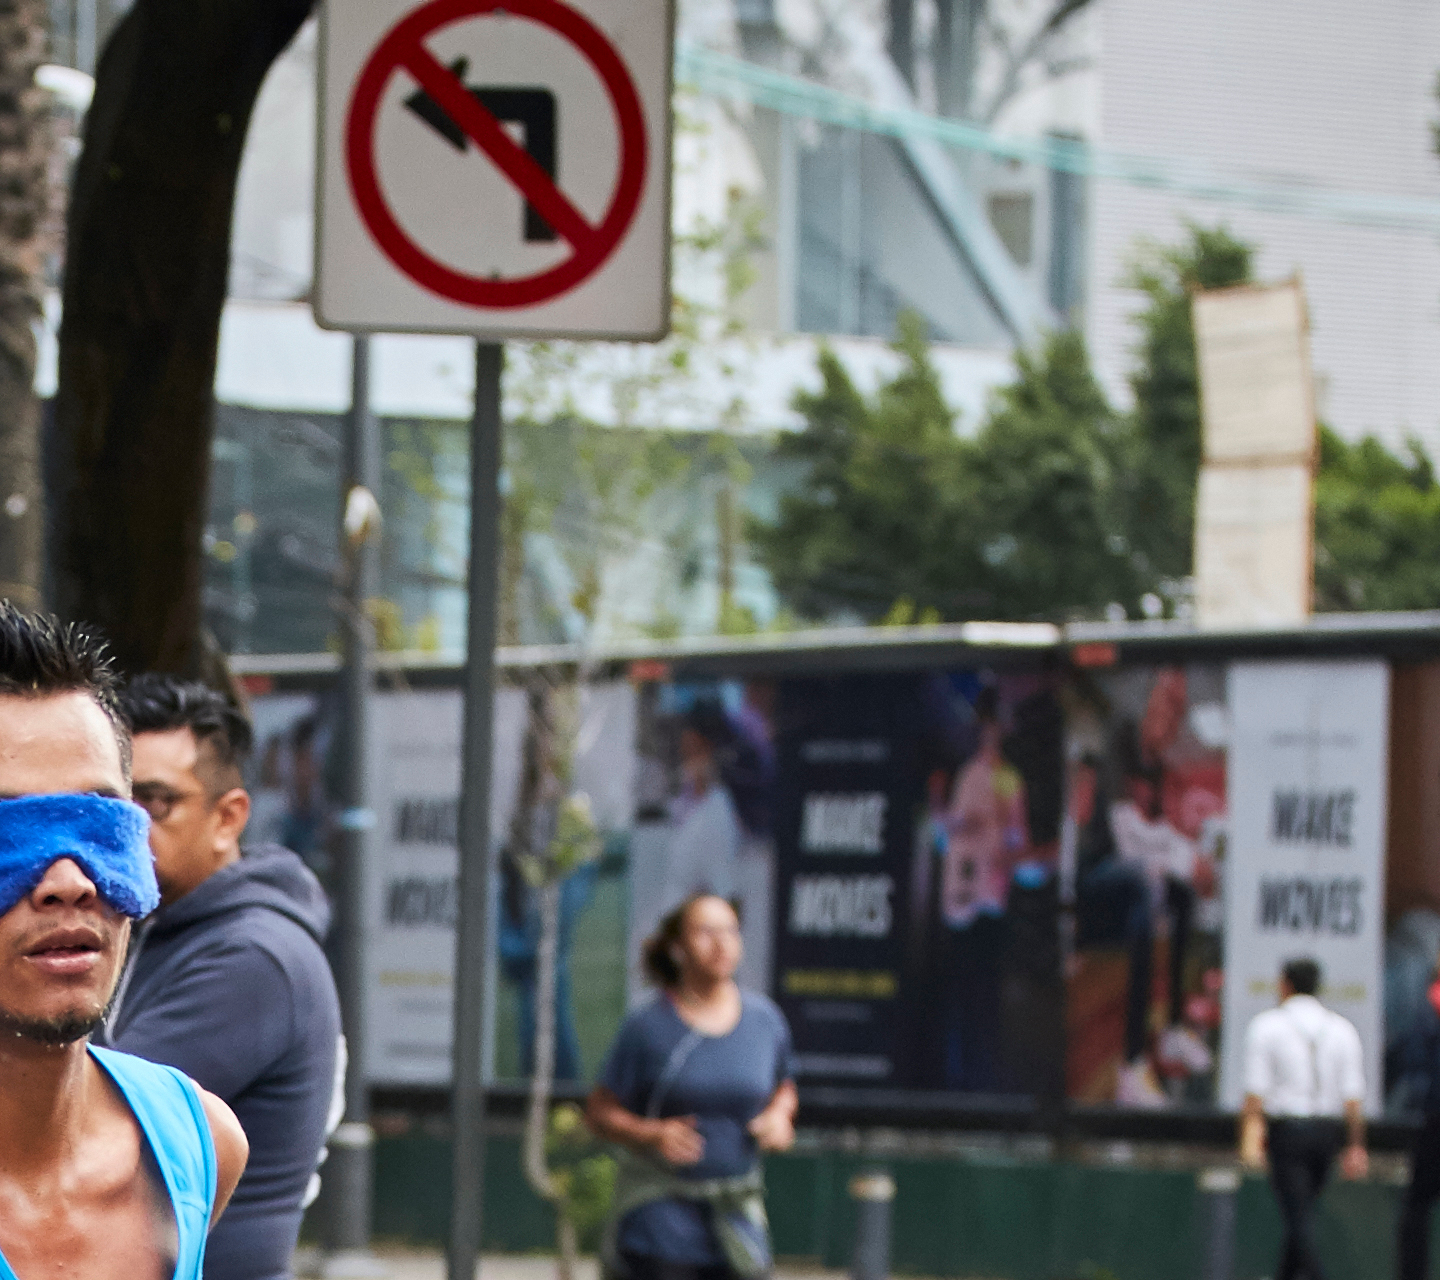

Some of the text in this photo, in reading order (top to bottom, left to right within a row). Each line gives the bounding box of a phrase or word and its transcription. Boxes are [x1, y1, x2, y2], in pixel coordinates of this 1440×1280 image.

[799, 791, 889, 852] MAKE
[1271, 790, 1357, 846] MAKE
[788, 873, 894, 937] MOVES
[1258, 878, 1364, 935] MOVES
